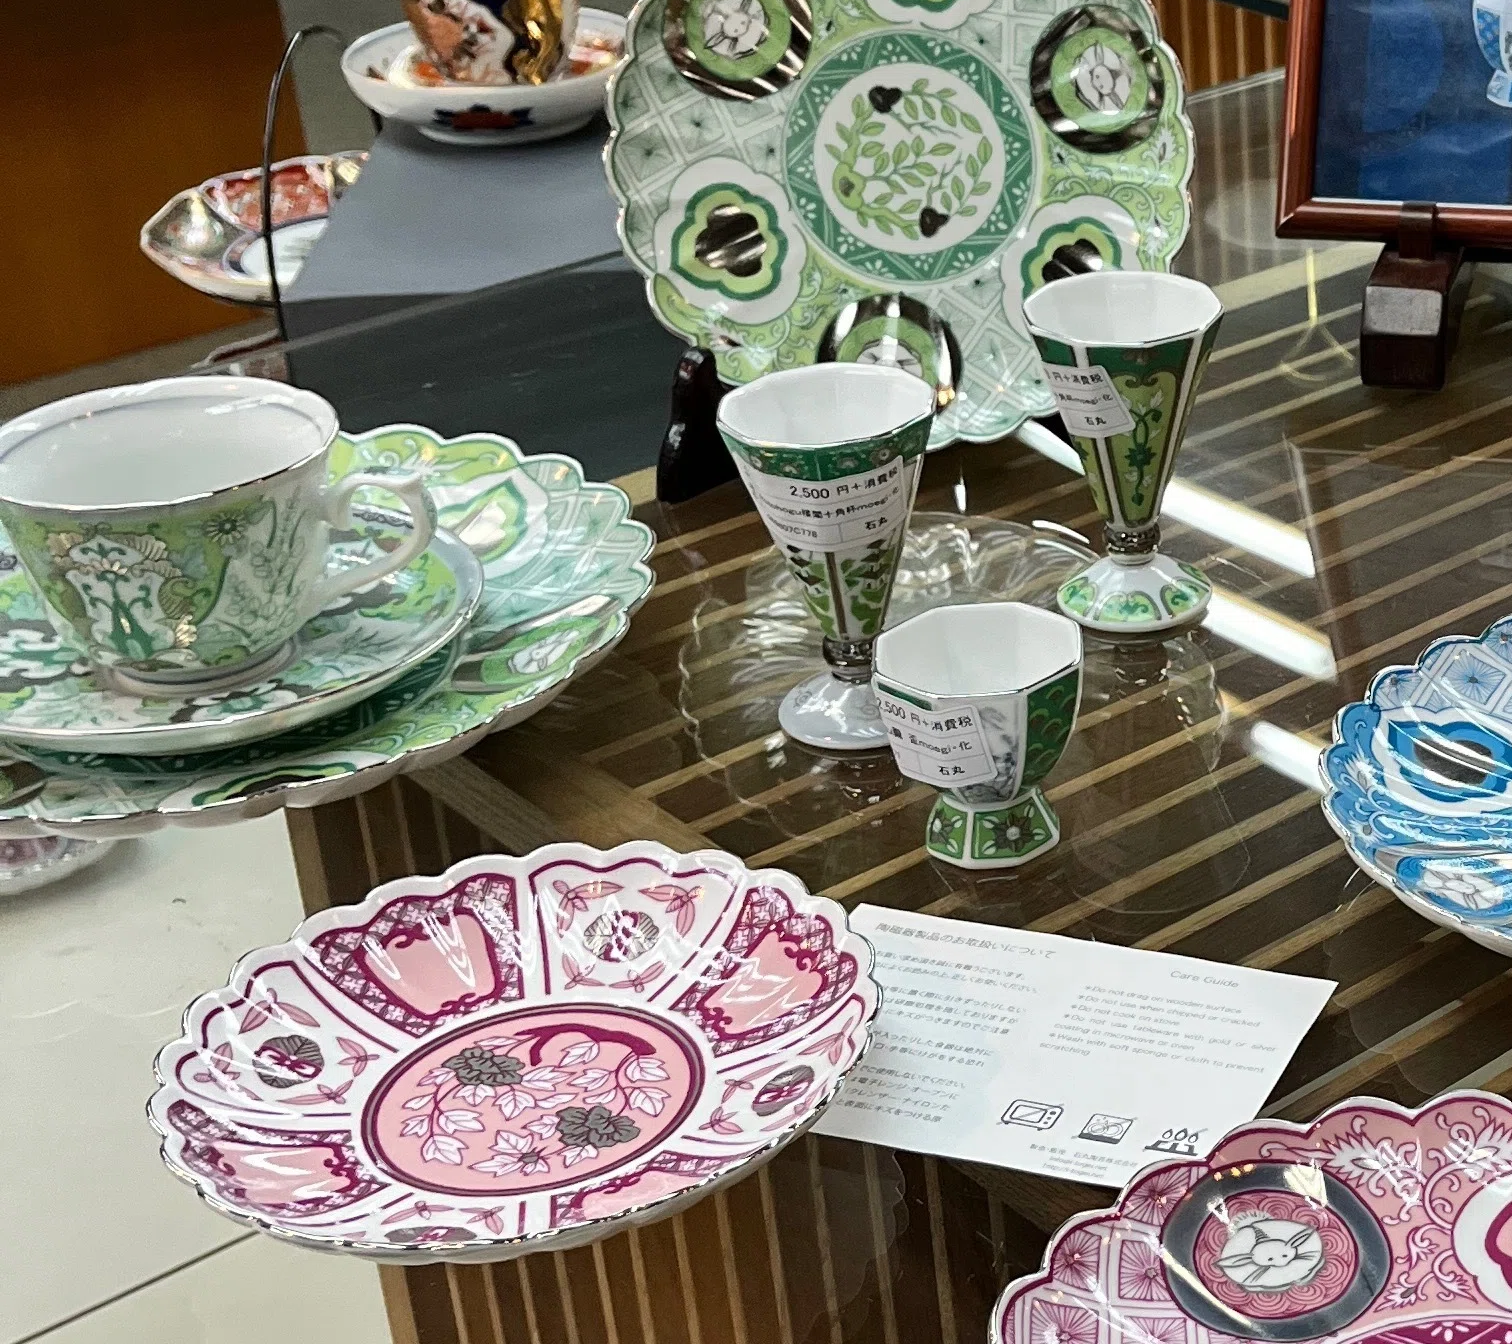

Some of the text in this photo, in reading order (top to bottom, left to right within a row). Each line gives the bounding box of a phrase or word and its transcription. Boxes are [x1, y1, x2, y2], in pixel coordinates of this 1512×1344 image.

[789, 485, 830, 500] 2,500
[865, 516, 888, 531] 石丸
[938, 765, 965, 775] 石丸
[1169, 970, 1240, 988] Care Guide
